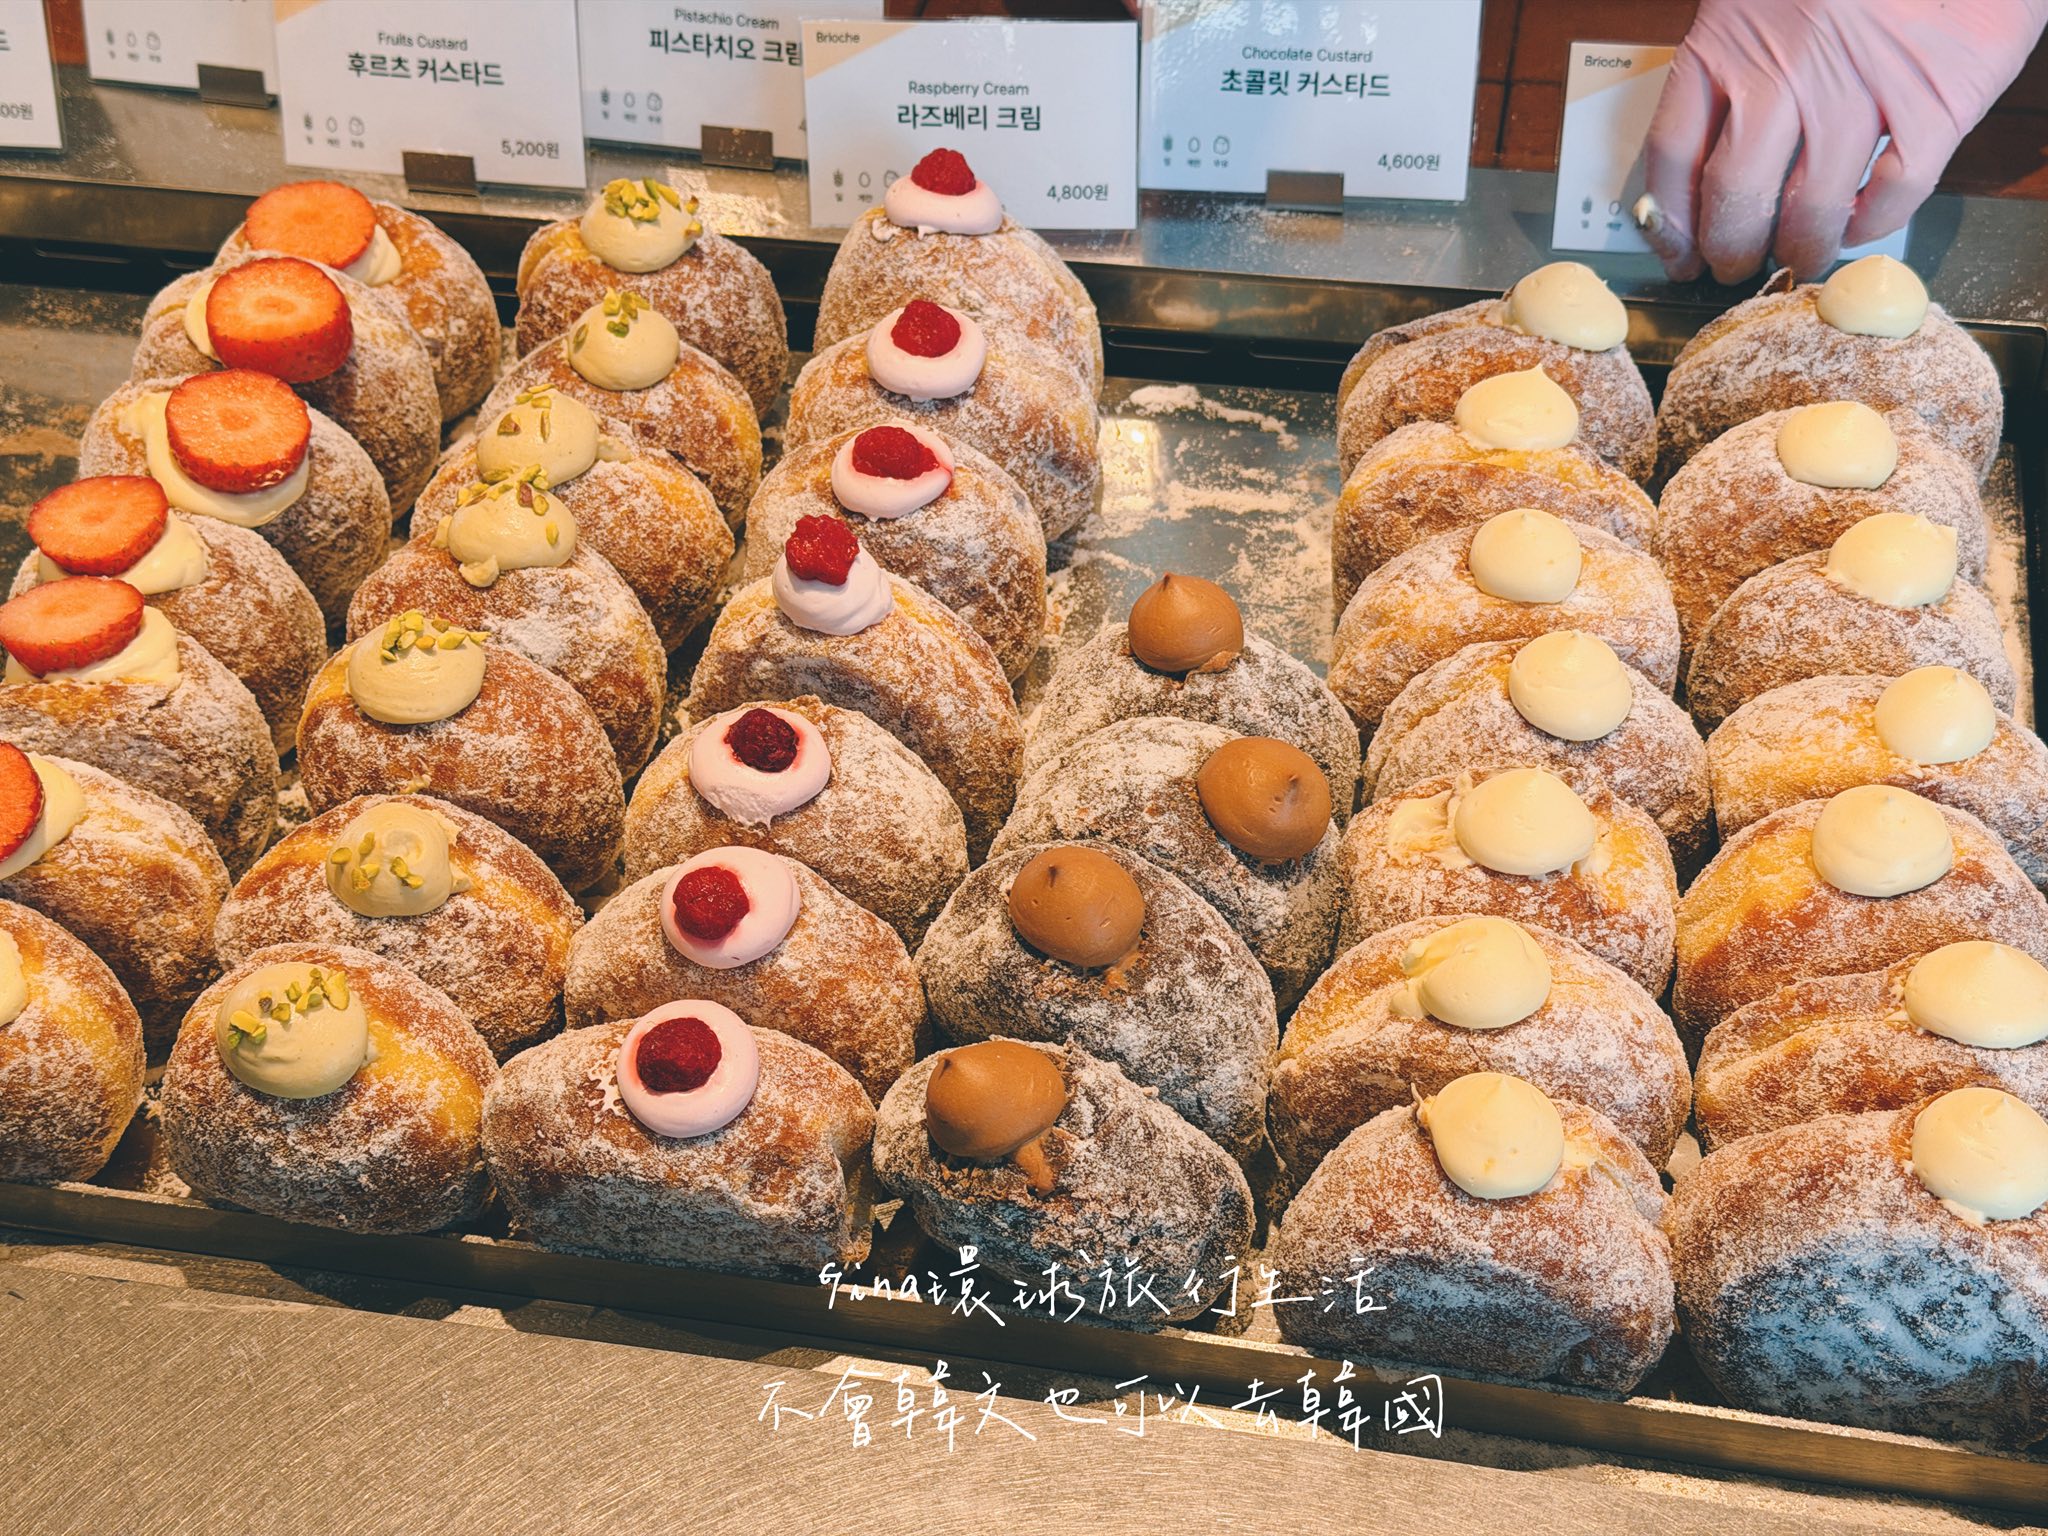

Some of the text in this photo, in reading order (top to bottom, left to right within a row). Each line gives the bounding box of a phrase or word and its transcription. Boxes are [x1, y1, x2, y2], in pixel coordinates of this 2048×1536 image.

[674, 8, 779, 30] Pistachio Cream
[378, 32, 468, 50] Fruits Custard
[816, 31, 861, 44] Brioche
[649, 29, 803, 67] 피스타치오 크림
[1241, 47, 1373, 63] Chocolate Custard
[348, 52, 505, 86] 후르츠 커스타드
[1584, 55, 1632, 69] Brioche
[908, 81, 1030, 98] Raspberry Cream
[1220, 68, 1391, 99] 초콜릿 커스타드
[897, 103, 1041, 131] 라즈베리 크림
[501, 139, 560, 159] 5,200원
[1378, 153, 1440, 172] 4,600원
[1047, 183, 1109, 203] 4,800원
